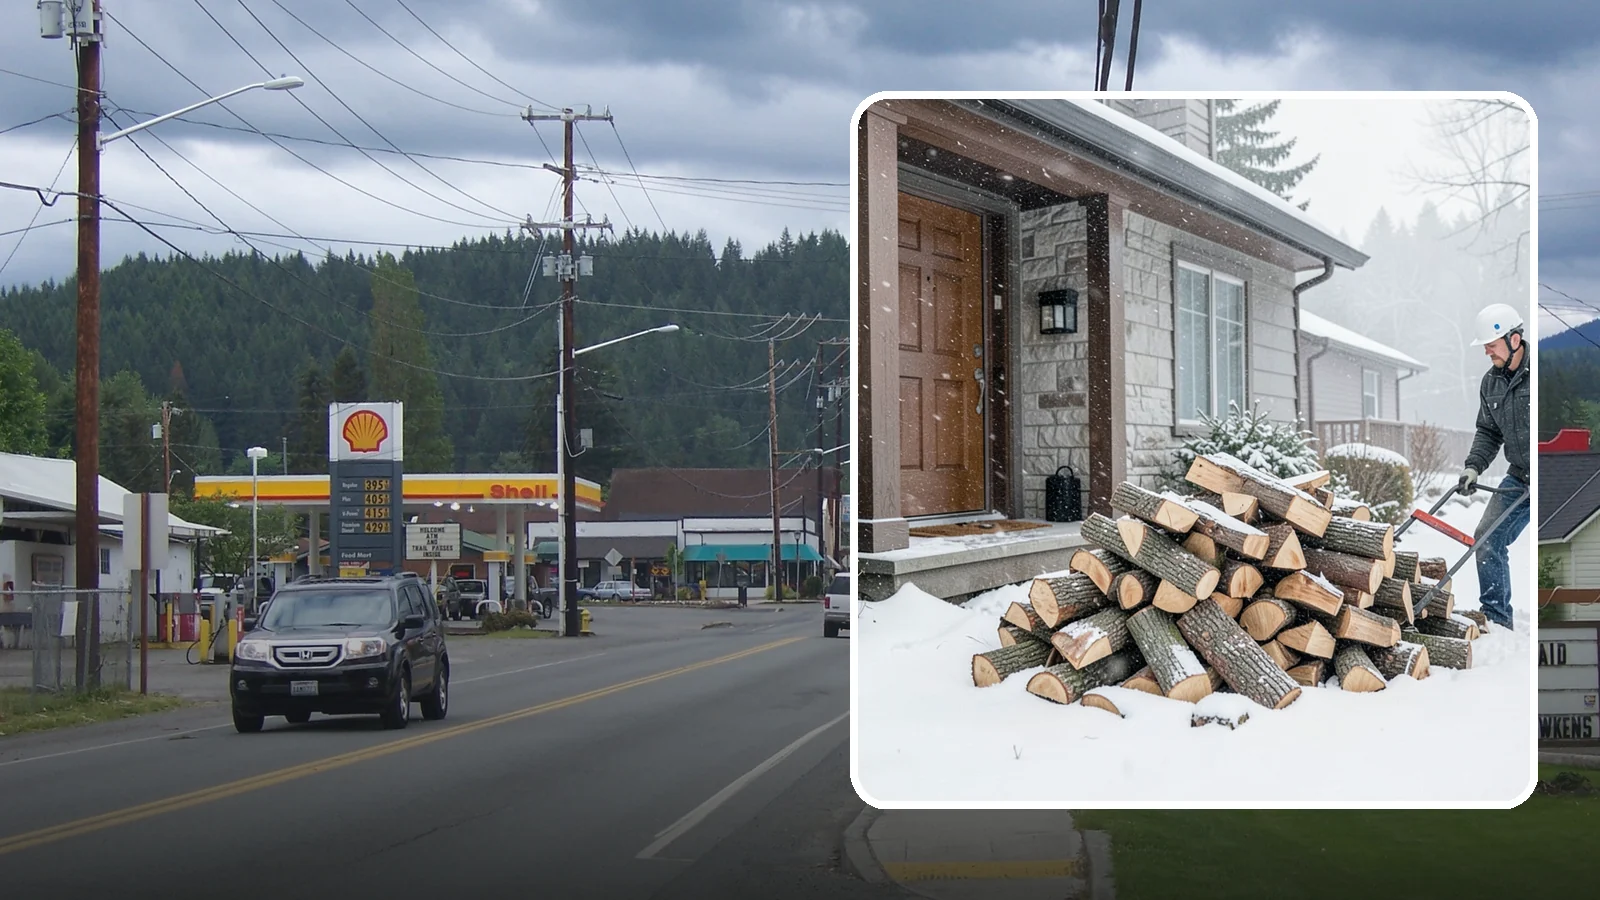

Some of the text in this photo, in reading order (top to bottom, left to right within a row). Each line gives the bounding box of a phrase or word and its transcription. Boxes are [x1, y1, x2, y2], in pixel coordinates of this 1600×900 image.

[366, 480, 384, 490] 395
[490, 484, 547, 499] Shell
[366, 494, 384, 504] 405
[366, 508, 384, 518] 415
[366, 522, 384, 533] 429
[1539, 642, 1567, 666] AID
